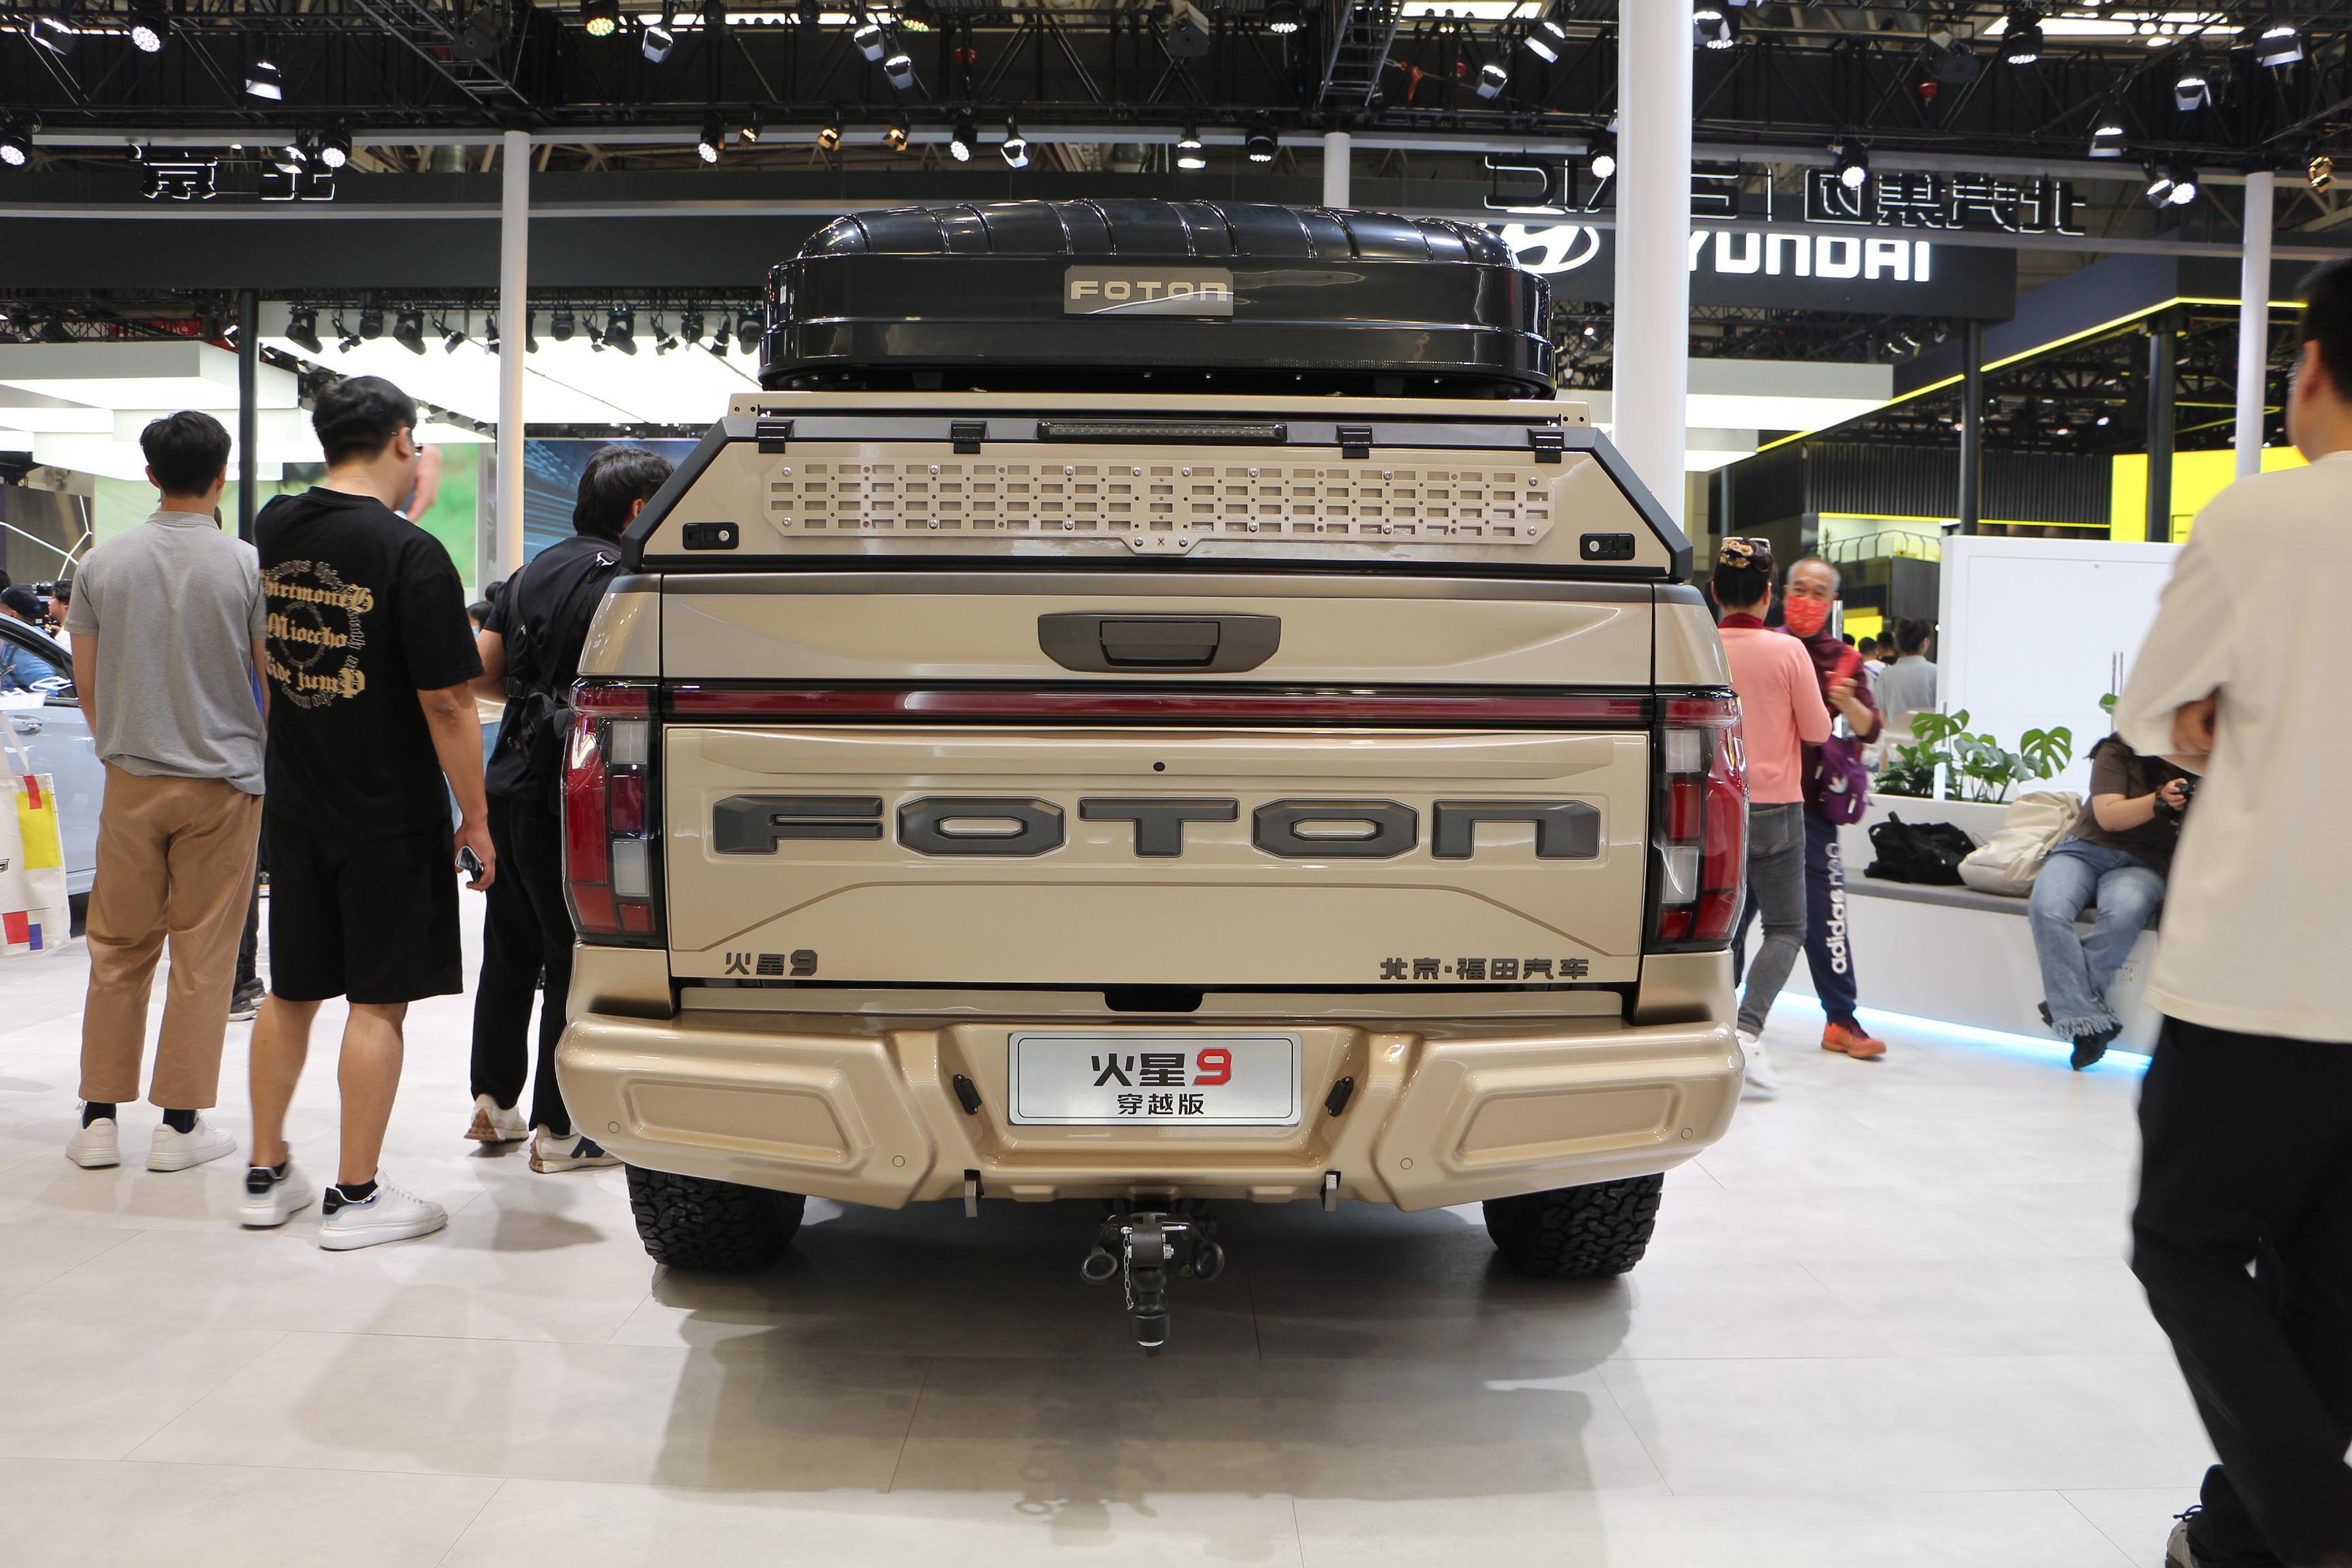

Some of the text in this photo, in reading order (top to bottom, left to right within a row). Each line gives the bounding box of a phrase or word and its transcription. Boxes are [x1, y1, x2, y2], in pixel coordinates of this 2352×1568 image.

[1071, 280, 1228, 302] FOTON
[713, 794, 1601, 860] FOTON
[1825, 888, 1848, 975] adidas
[724, 949, 818, 977] 火星9
[1379, 957, 1589, 981] 北京·福田汽车
[1090, 1048, 1232, 1088] 火星9
[1117, 1093, 1205, 1115] 穿越版
